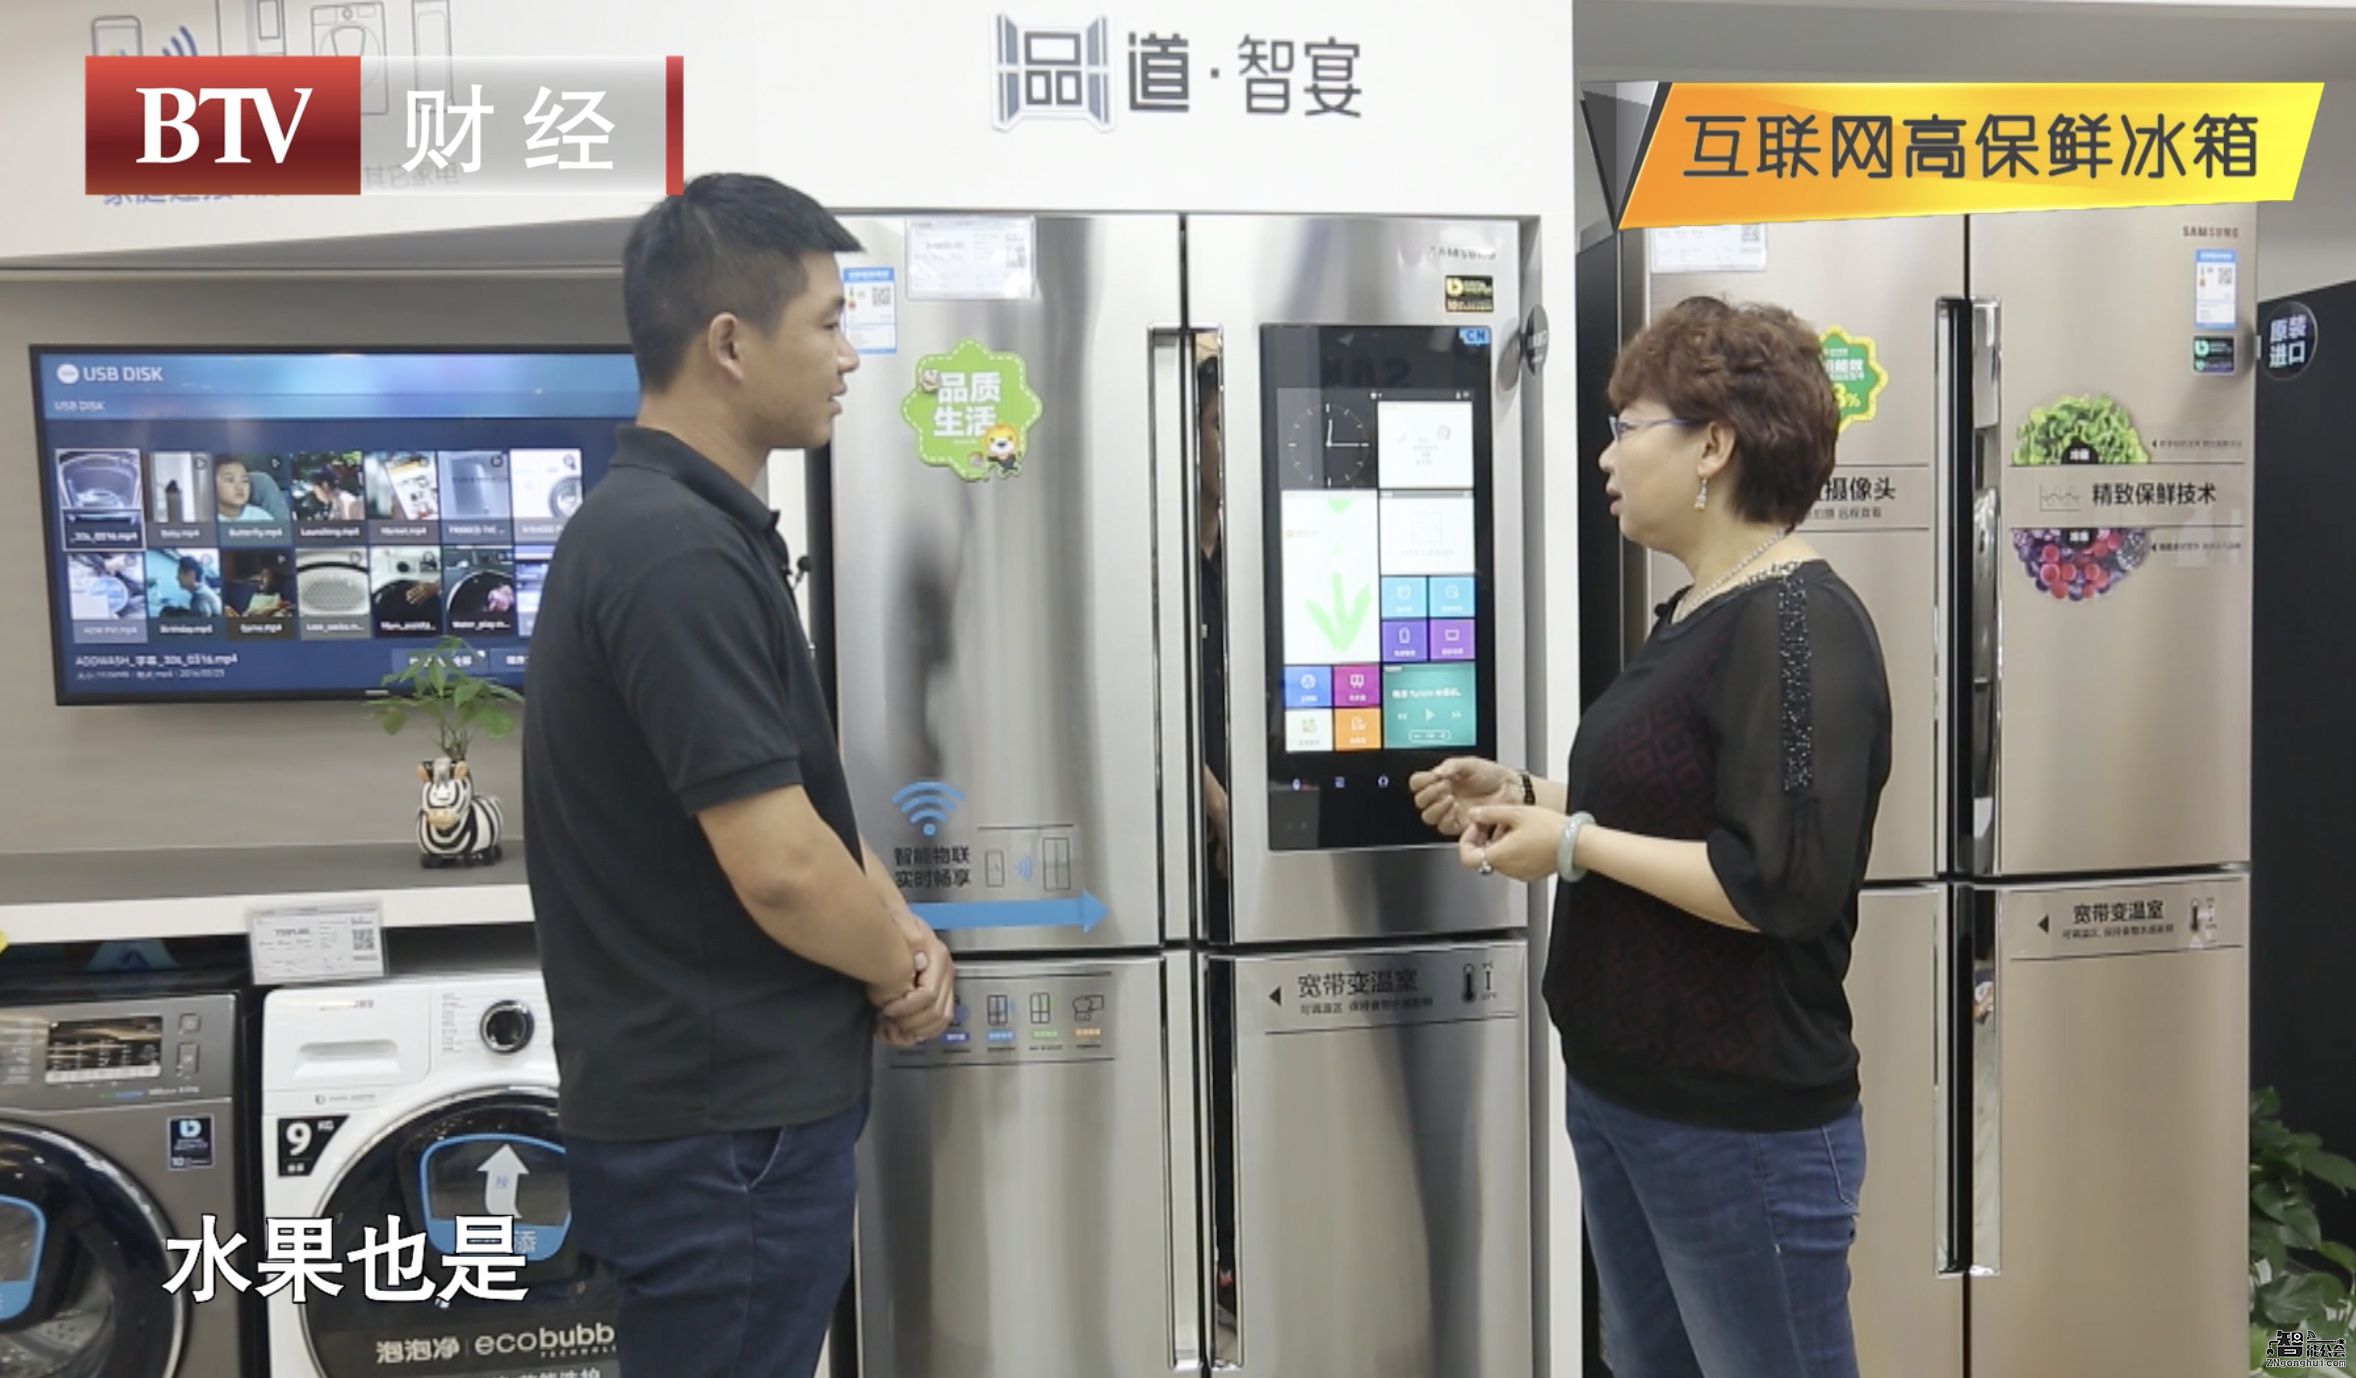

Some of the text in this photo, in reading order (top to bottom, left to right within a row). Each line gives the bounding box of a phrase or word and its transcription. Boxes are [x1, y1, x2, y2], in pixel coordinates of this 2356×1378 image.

[2183, 225, 2240, 239] SAMSUNG
[2270, 315, 2307, 342] 原装
[2269, 342, 2306, 368] 进口
[84, 366, 164, 382] USB DISK
[937, 372, 1002, 403] 品质
[933, 405, 997, 438] 生活
[1819, 476, 1897, 502] 摄像头
[2092, 482, 2217, 506] 精致保鲜技术
[894, 845, 971, 866] 智能物联
[894, 869, 971, 889] 实时畅享
[2073, 900, 2164, 925] 宽带变温室
[1298, 968, 1419, 999] 宽带变温室
[286, 1121, 312, 1157] 9
[376, 1336, 461, 1364] 泡泡净
